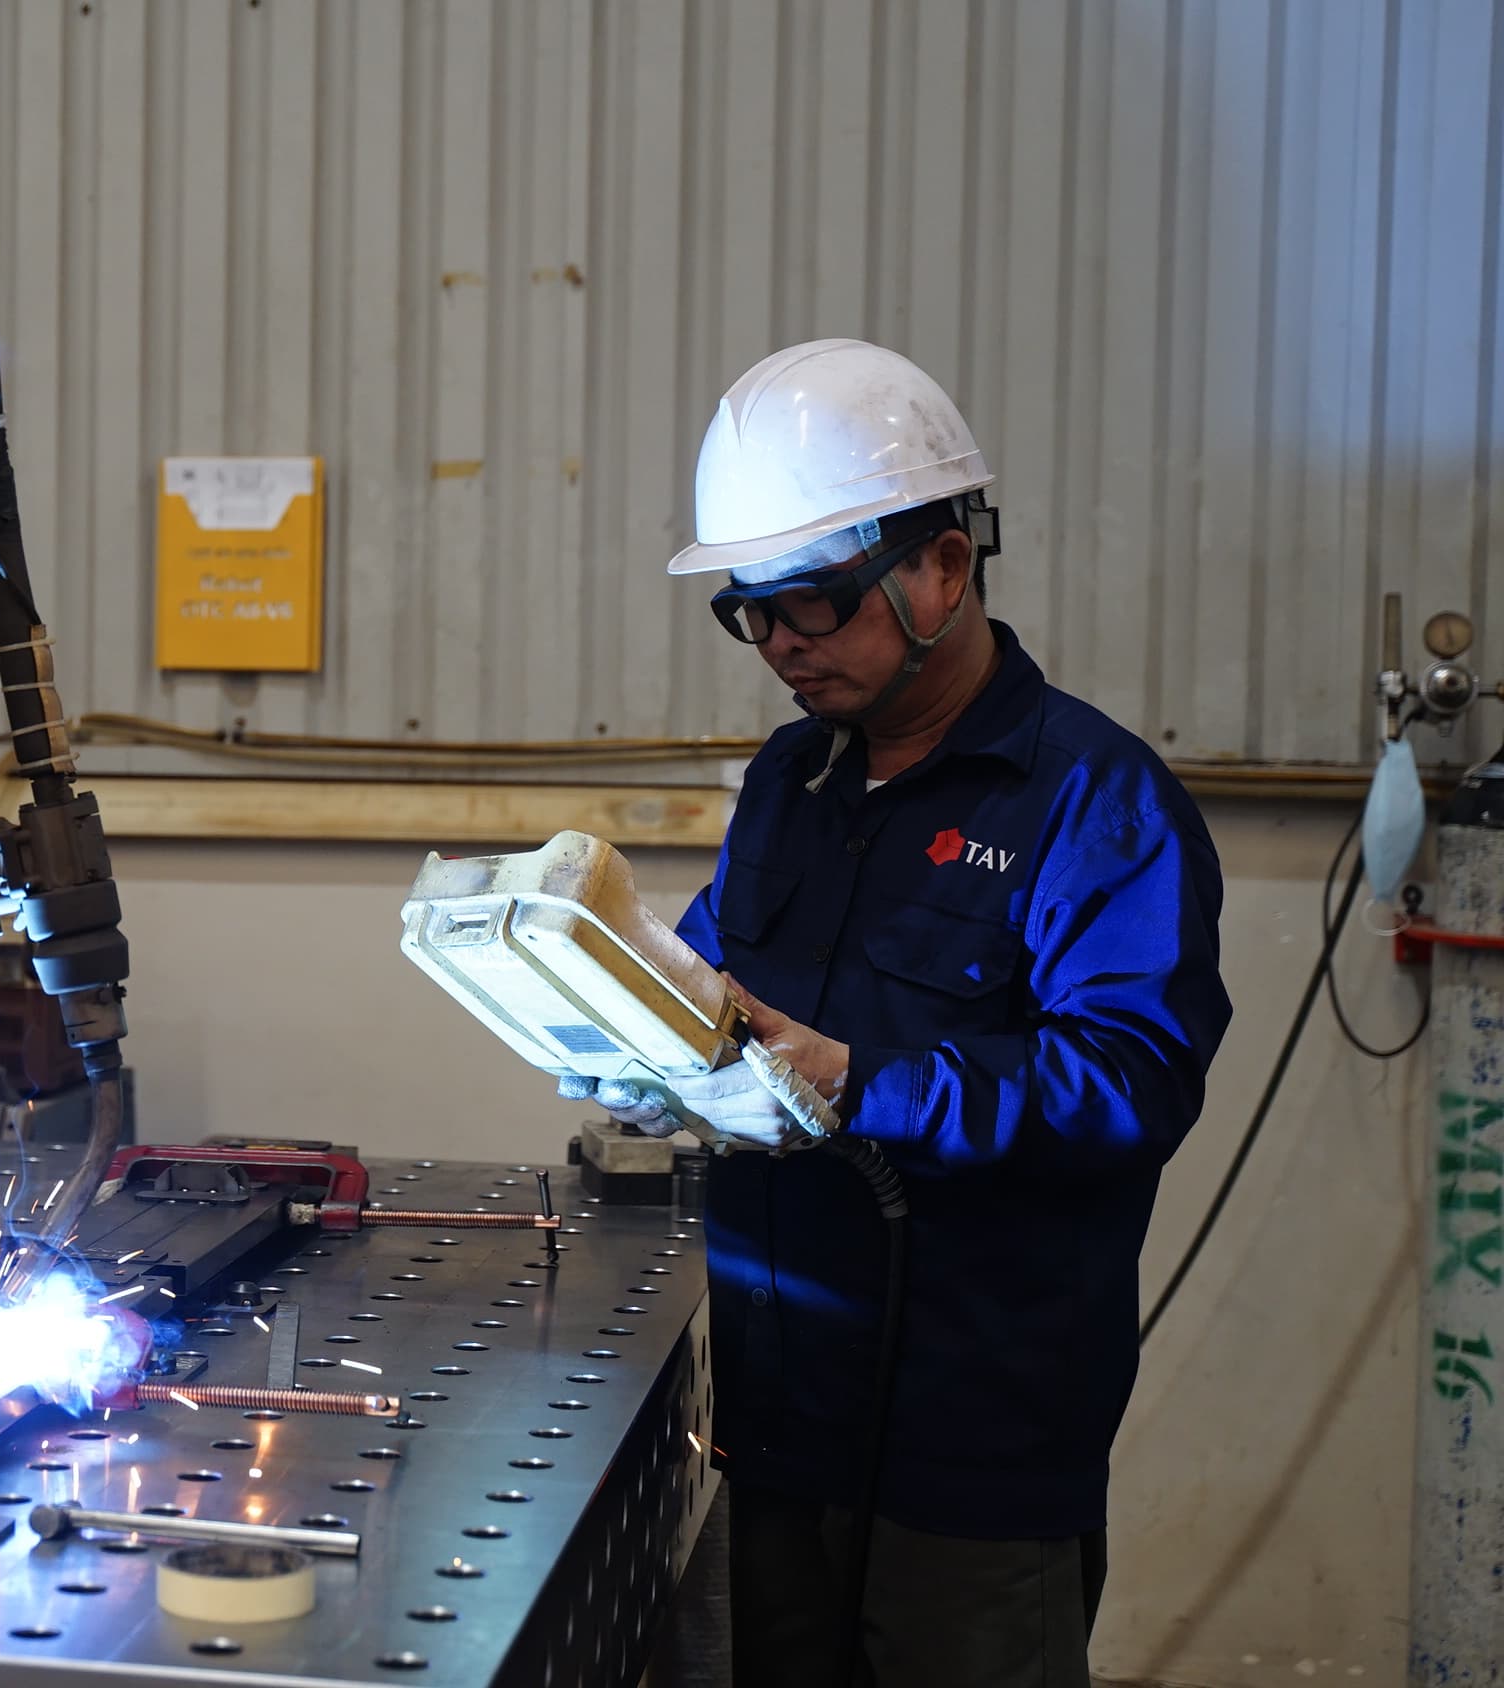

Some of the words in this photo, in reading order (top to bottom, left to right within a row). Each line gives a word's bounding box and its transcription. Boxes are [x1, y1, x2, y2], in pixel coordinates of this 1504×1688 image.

[965, 840, 1016, 873] TAV
[1435, 1091, 1504, 1287] MIX
[1433, 1327, 1495, 1407] 16
